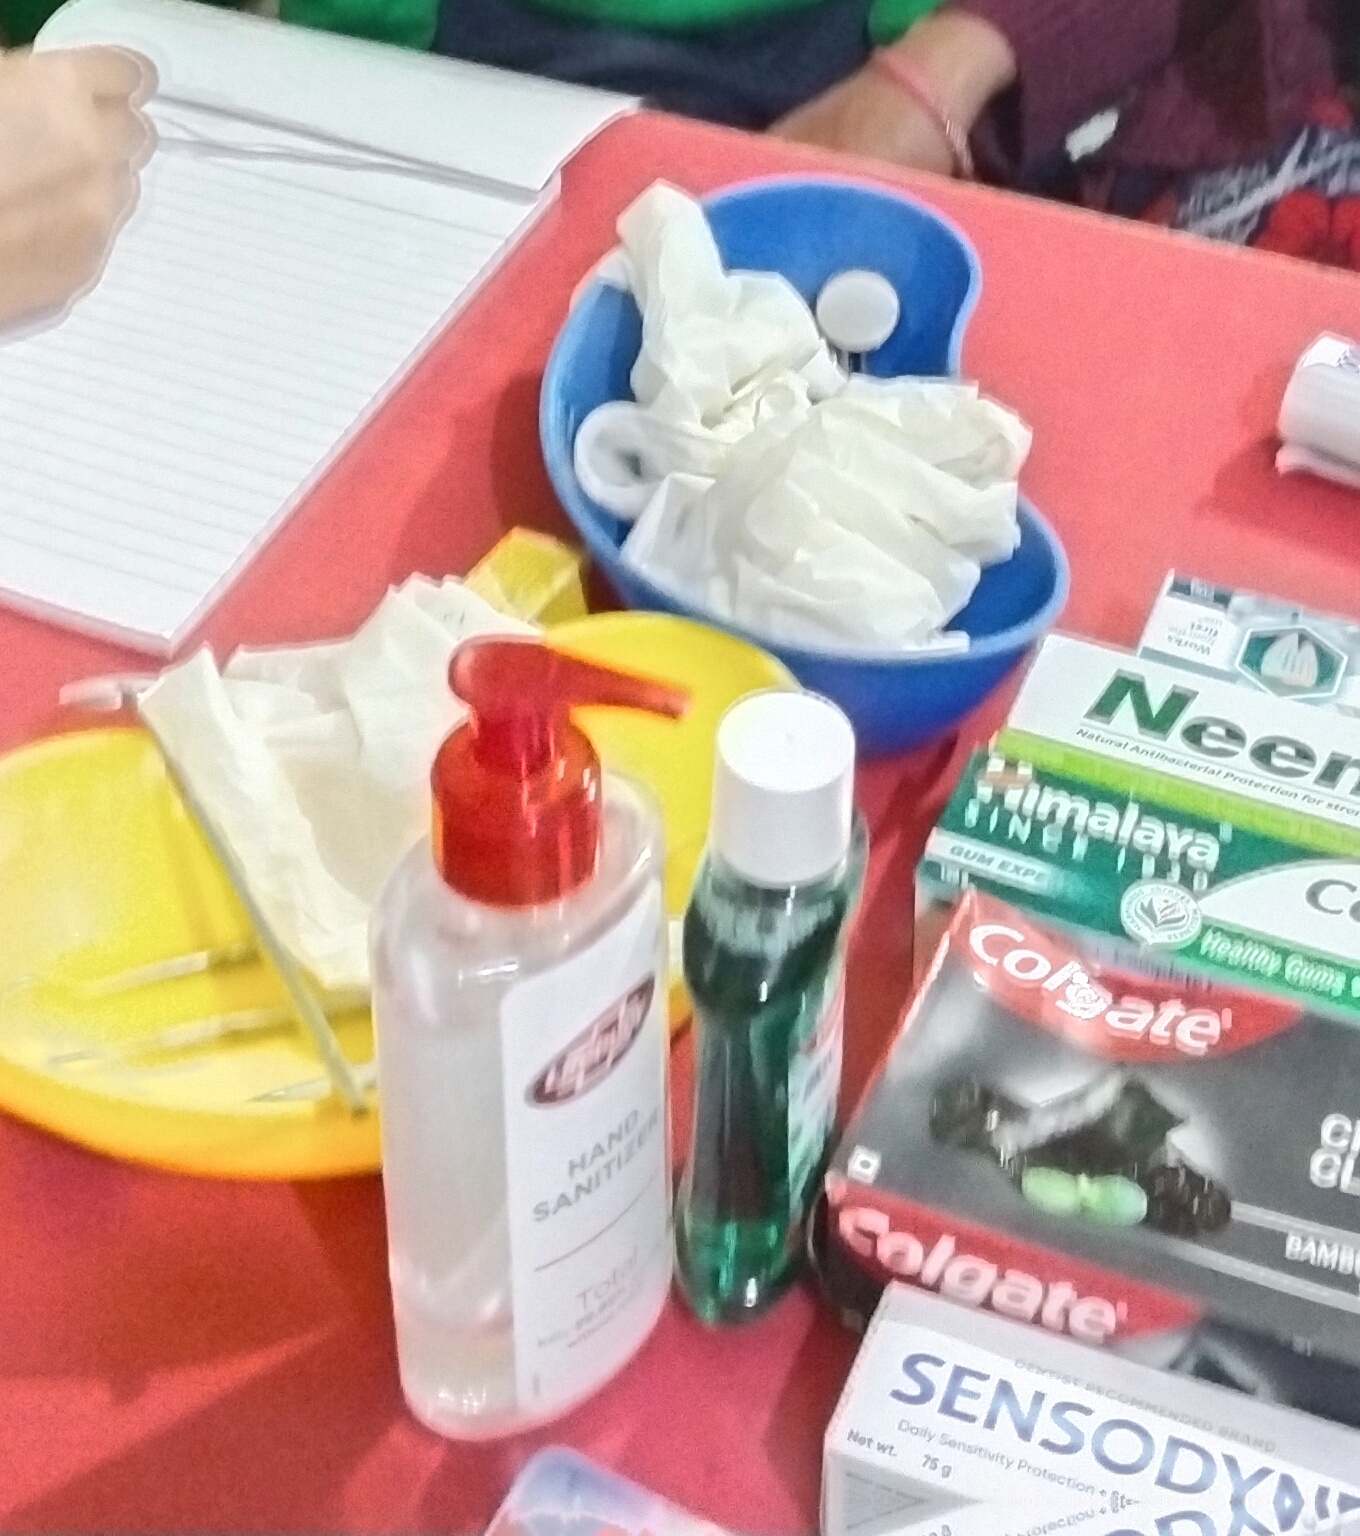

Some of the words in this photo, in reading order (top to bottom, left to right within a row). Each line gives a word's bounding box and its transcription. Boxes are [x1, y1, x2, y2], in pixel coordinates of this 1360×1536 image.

[1076, 727, 1129, 751] Natural
[1223, 768, 1299, 801] Protection
[1301, 794, 1325, 806] for
[975, 751, 1220, 873] Himalaya
[949, 843, 996, 870] GUM
[968, 923, 1222, 1057] Colgate
[1200, 928, 1282, 977] Healthy
[1284, 953, 1347, 997] Gums
[566, 1109, 640, 1179] HAND
[838, 1205, 1118, 1345] Colgate
[846, 1428, 875, 1449] Net
[921, 1452, 940, 1472] 75
[940, 1464, 953, 1479] g
[897, 1418, 937, 1446] Daily
[939, 1431, 1016, 1472] Sensitivity
[1017, 1457, 1096, 1495] Protection
